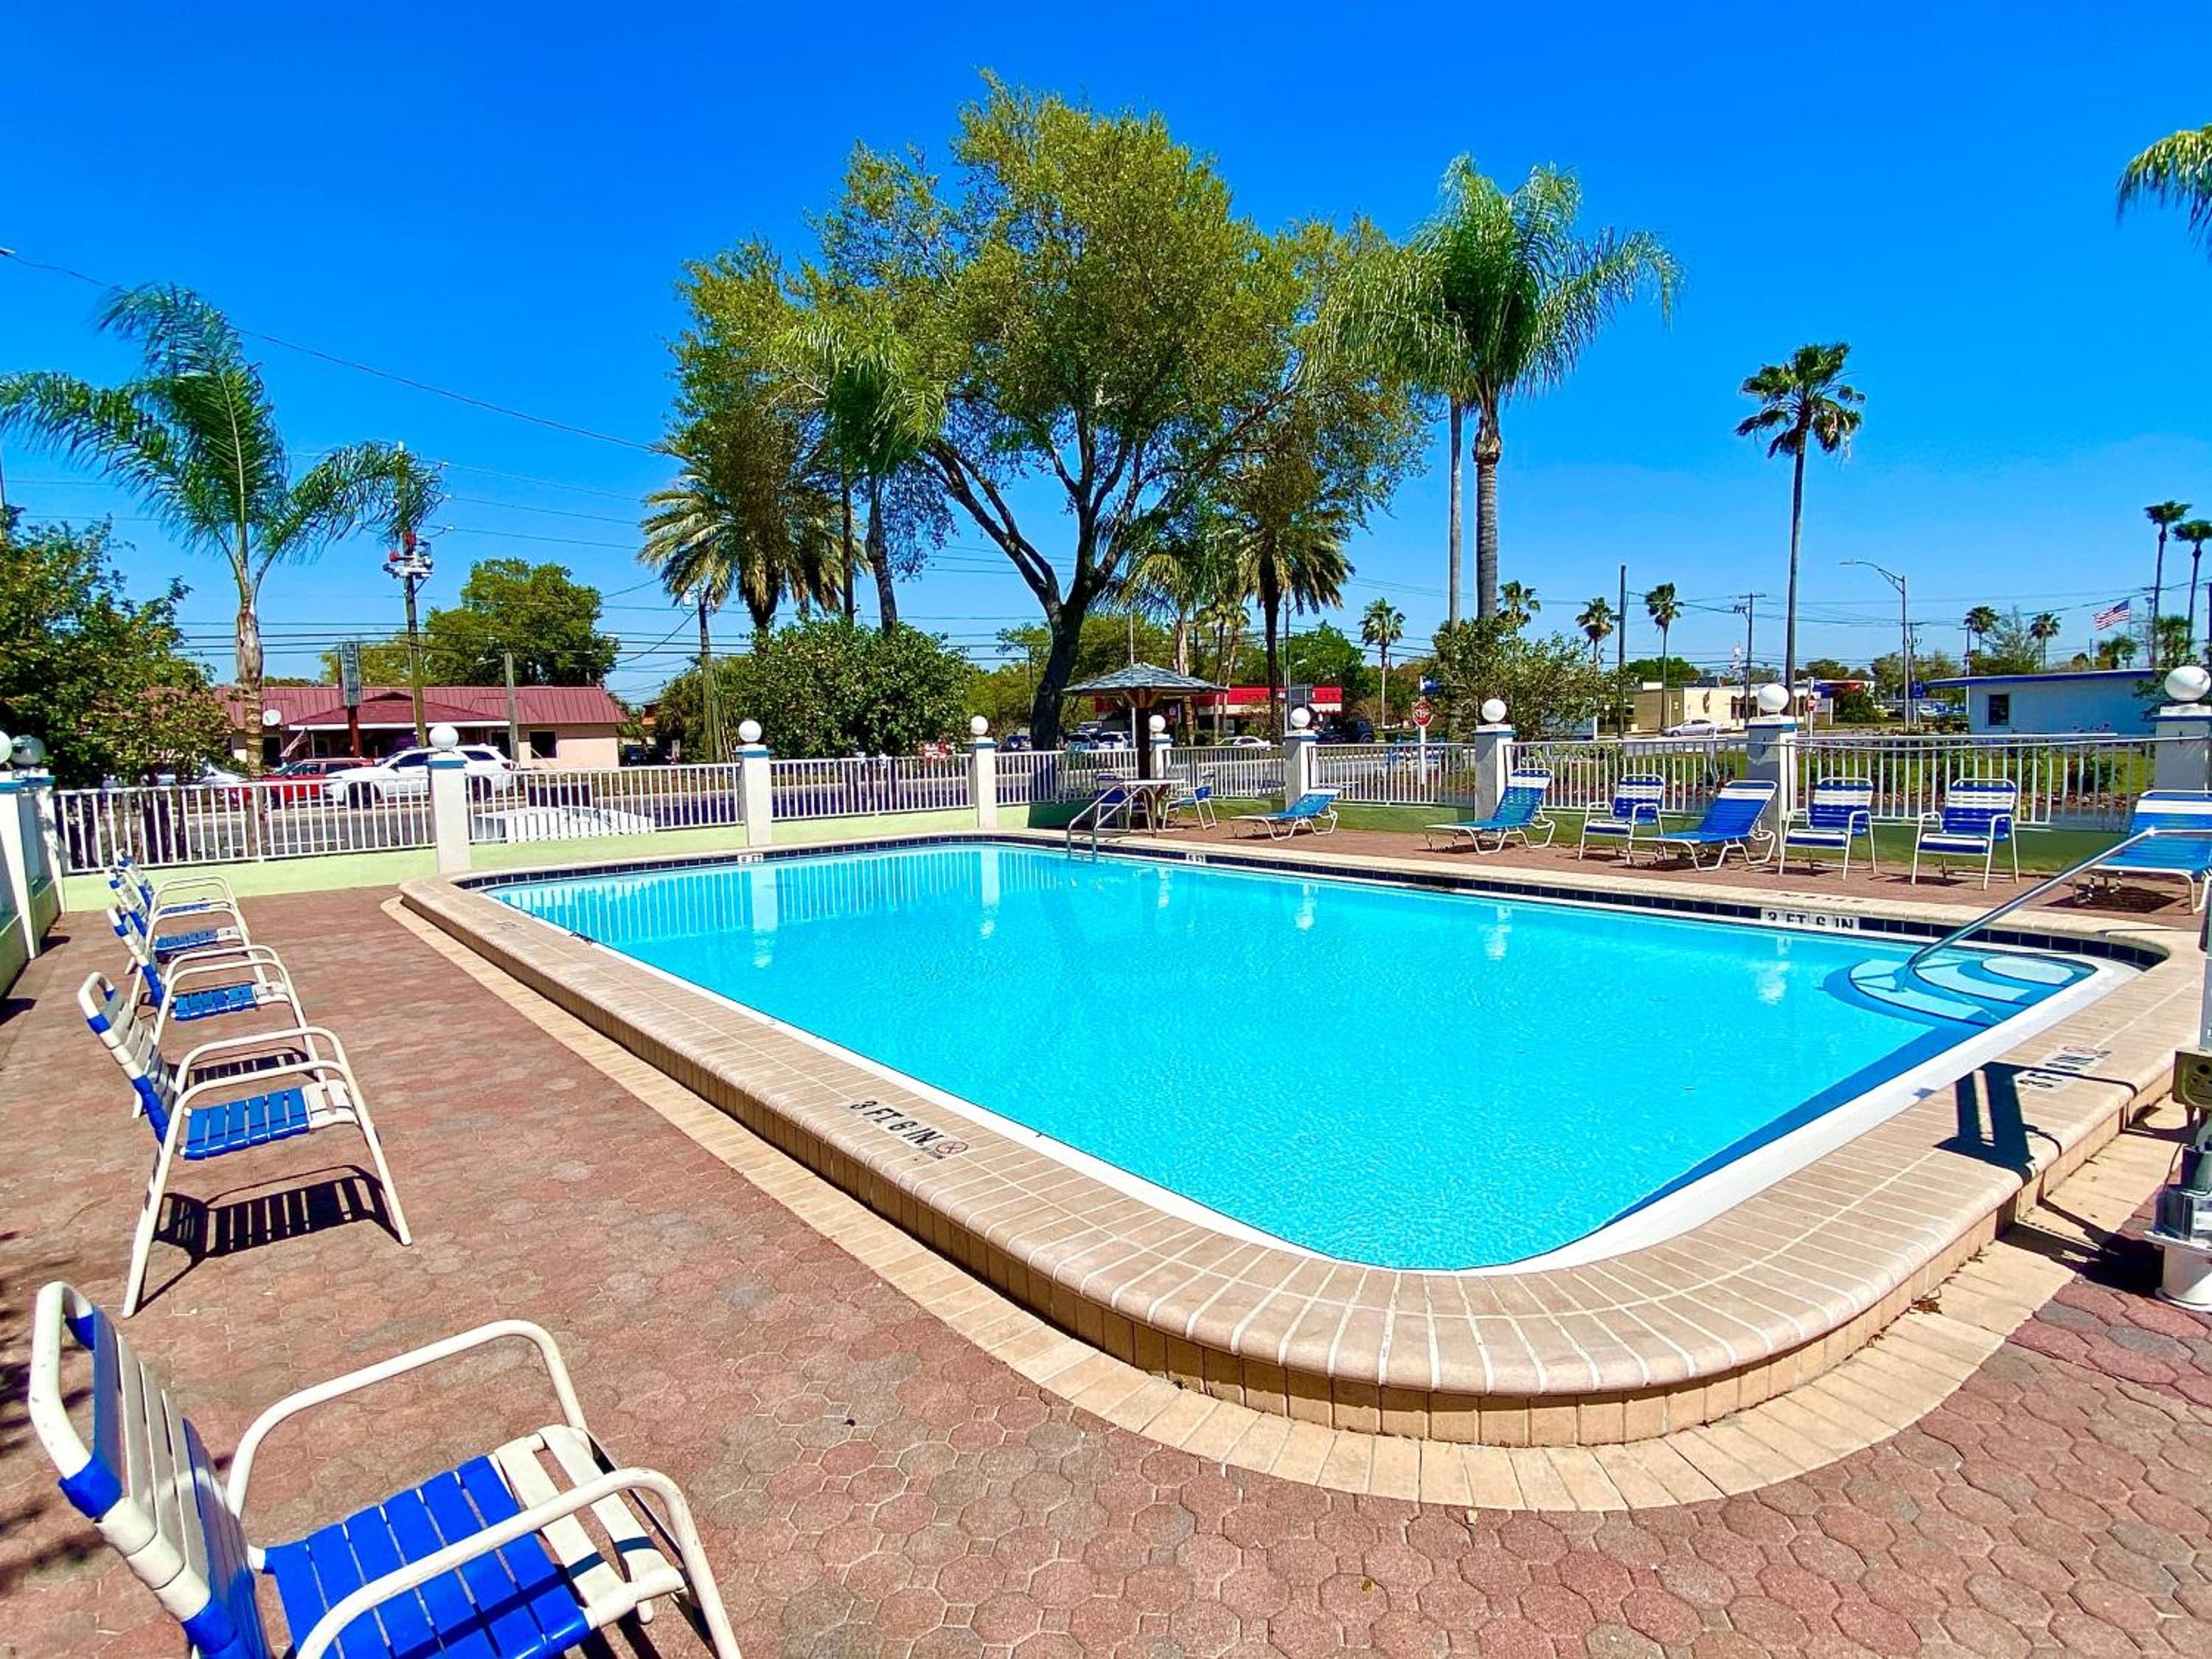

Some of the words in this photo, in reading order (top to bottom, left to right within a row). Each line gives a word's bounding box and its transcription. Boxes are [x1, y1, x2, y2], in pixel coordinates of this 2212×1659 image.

[1787, 913, 1806, 924] FT
[1835, 917, 1854, 929] IN
[849, 1100, 878, 1110] 3
[863, 1107, 905, 1123] FT
[901, 1127, 945, 1146] IN
